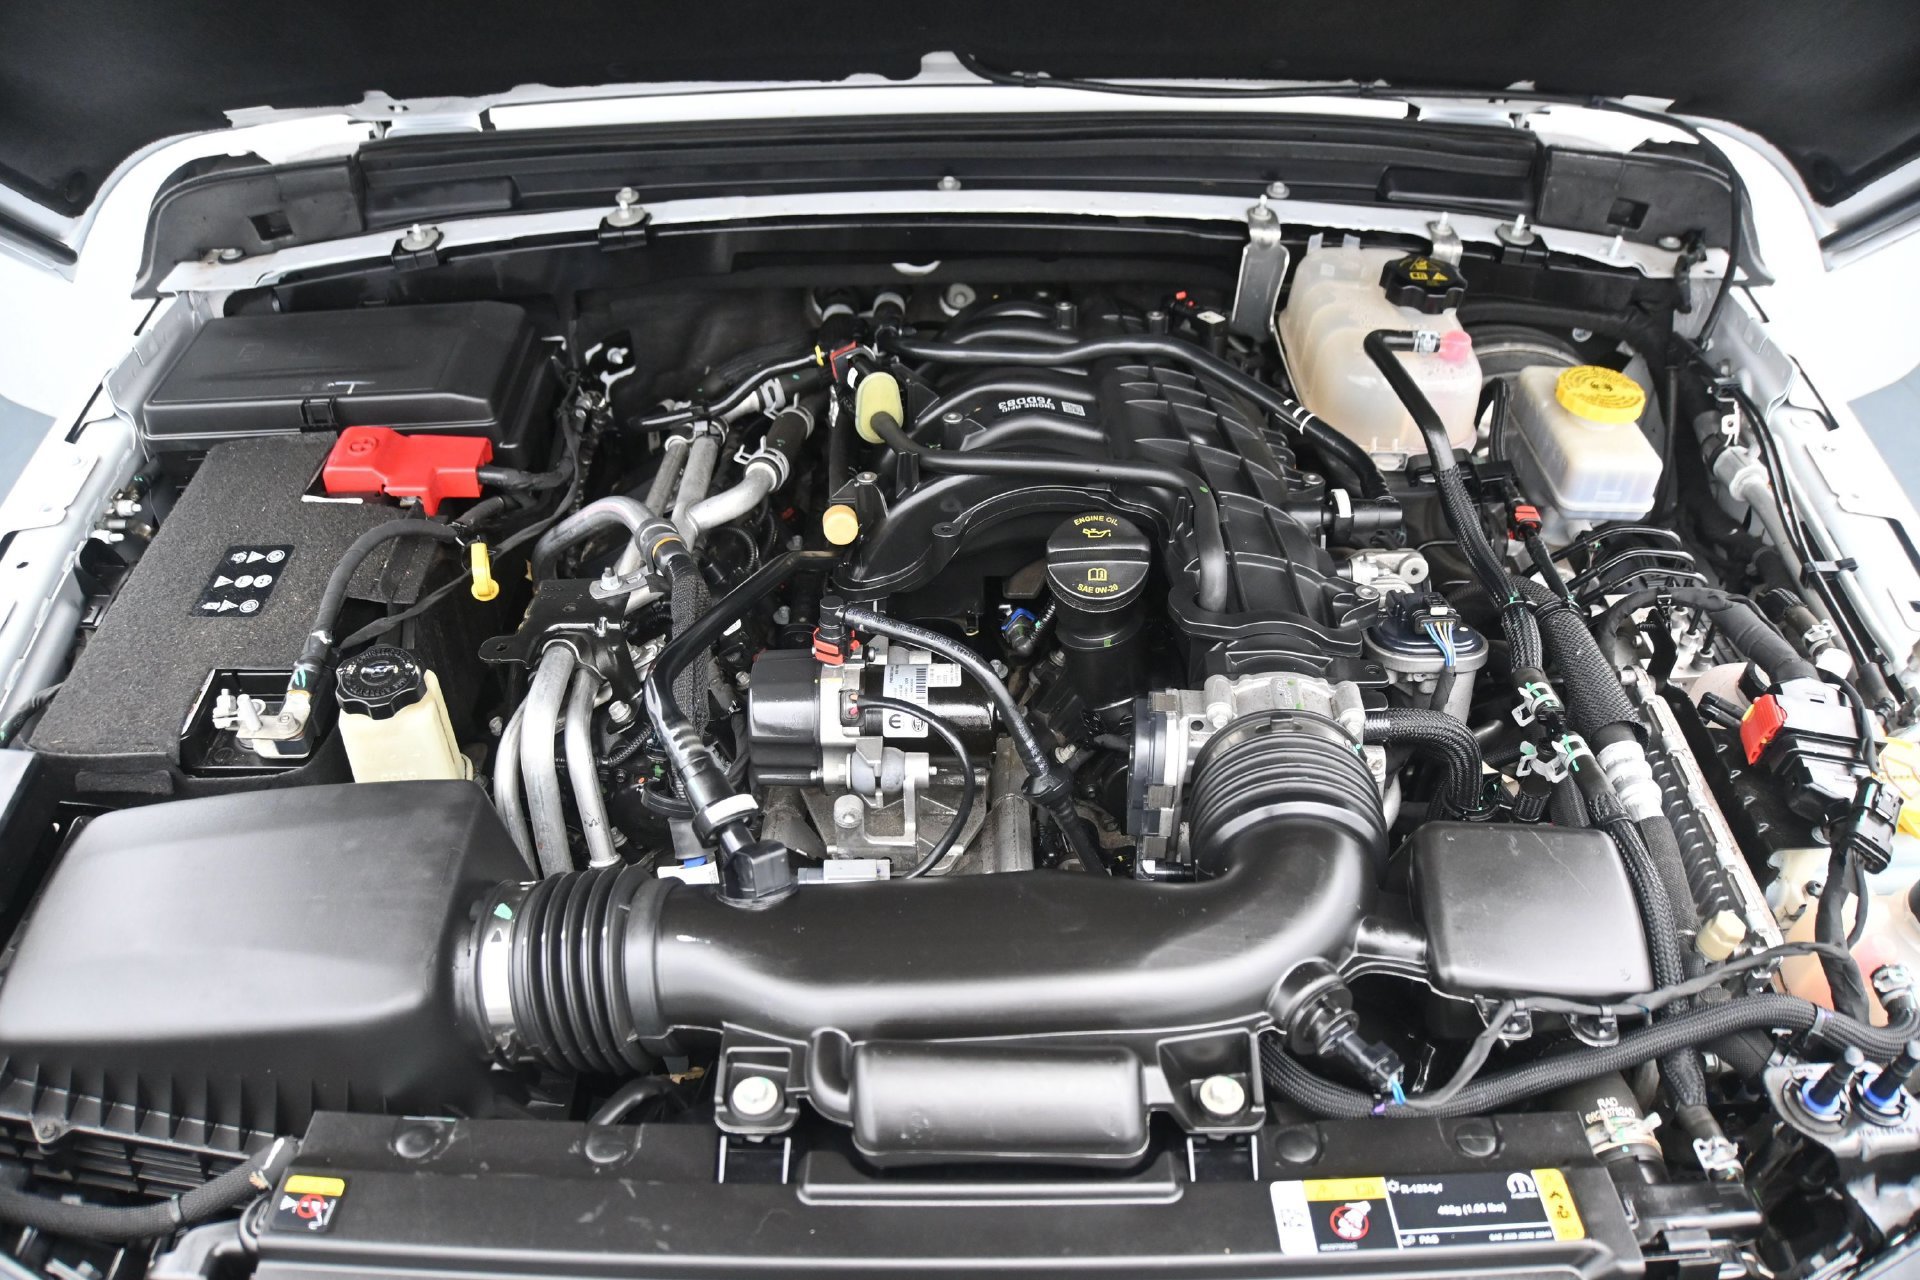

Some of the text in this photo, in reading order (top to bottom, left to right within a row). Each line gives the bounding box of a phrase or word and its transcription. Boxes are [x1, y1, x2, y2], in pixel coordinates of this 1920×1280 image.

[1073, 515, 1118, 526] ENGINE OIL
[1077, 583, 1119, 594] SAE 0W-20
[1596, 1096, 1619, 1111] RAD
